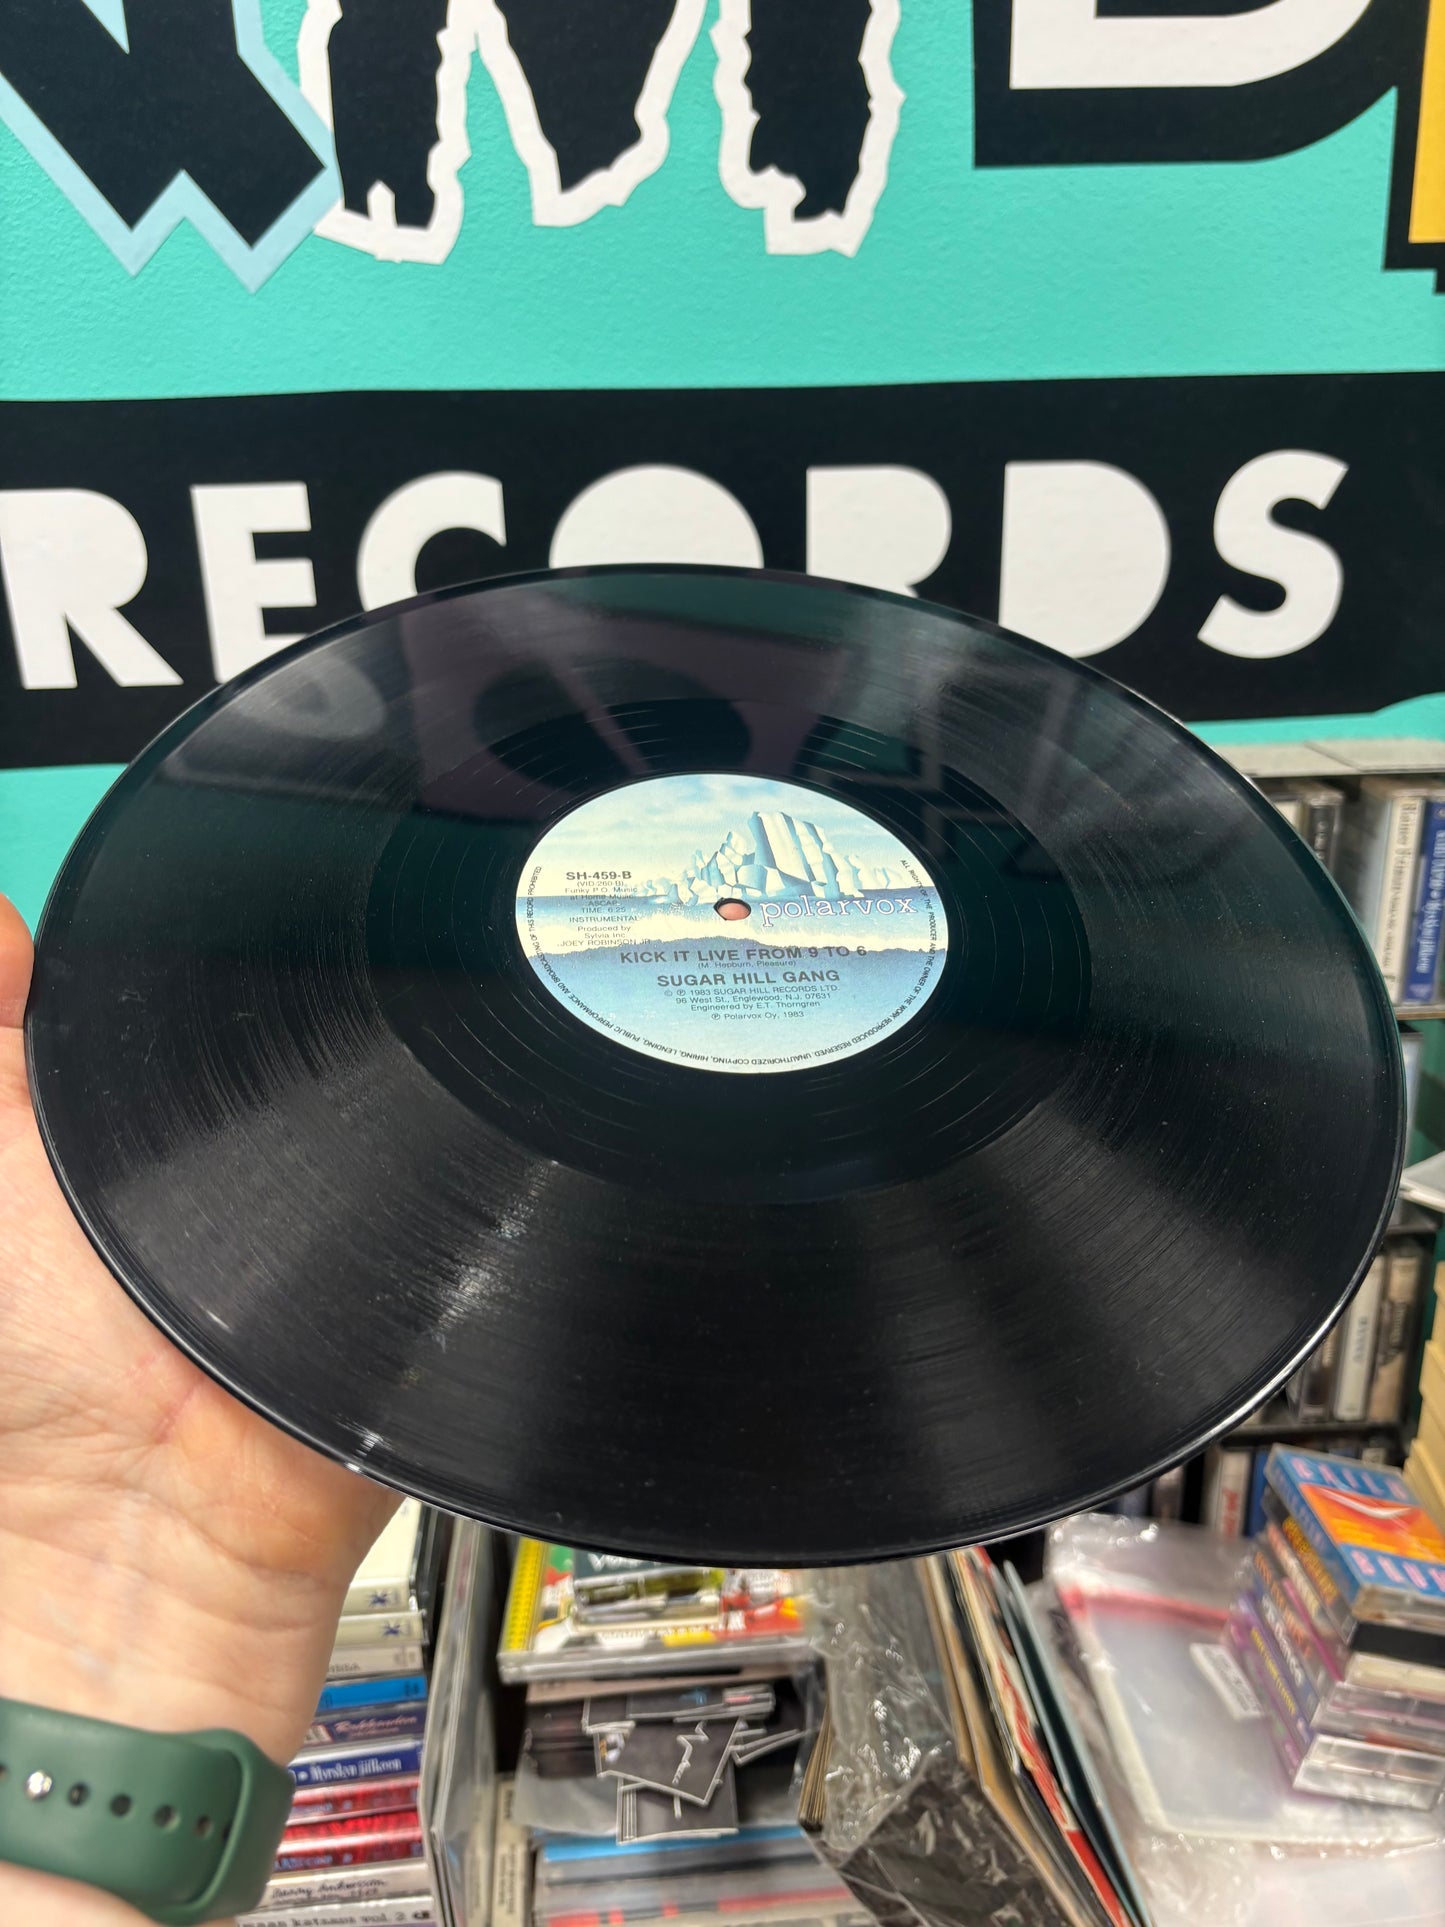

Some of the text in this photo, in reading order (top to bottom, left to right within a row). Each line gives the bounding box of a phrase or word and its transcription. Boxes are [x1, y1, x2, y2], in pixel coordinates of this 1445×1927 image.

[566, 871, 632, 880] SH-459-B
[760, 895, 918, 928] polarvox
[569, 915, 639, 923] INSTRUMENTAL
[620, 946, 867, 963] KICK IT LIVE FROM 9 TO 6
[657, 969, 840, 987] SUGAR HILL GANG
[557, 982, 572, 995] AND
[749, 986, 770, 994] HILL
[773, 985, 817, 993] RECORDS
[690, 996, 712, 1004] West
[733, 994, 783, 1003] Englewood,
[805, 992, 831, 1000] 07631
[904, 994, 917, 1006] THE
[568, 993, 615, 1029] PERFORMANCE
[691, 1004, 740, 1012] Engineered
[777, 1001, 821, 1009] Thorngren
[891, 1004, 908, 1020] WORK
[724, 1012, 761, 1020] Polarvox
[783, 1010, 804, 1018] 1983
[613, 1026, 641, 1042] PUBLIC
[642, 1037, 678, 1056] LENDING,
[680, 1050, 709, 1062] HIRING,
[710, 1054, 750, 1065] COPYING,
[751, 1053, 812, 1065] UNAUTHORIZED
